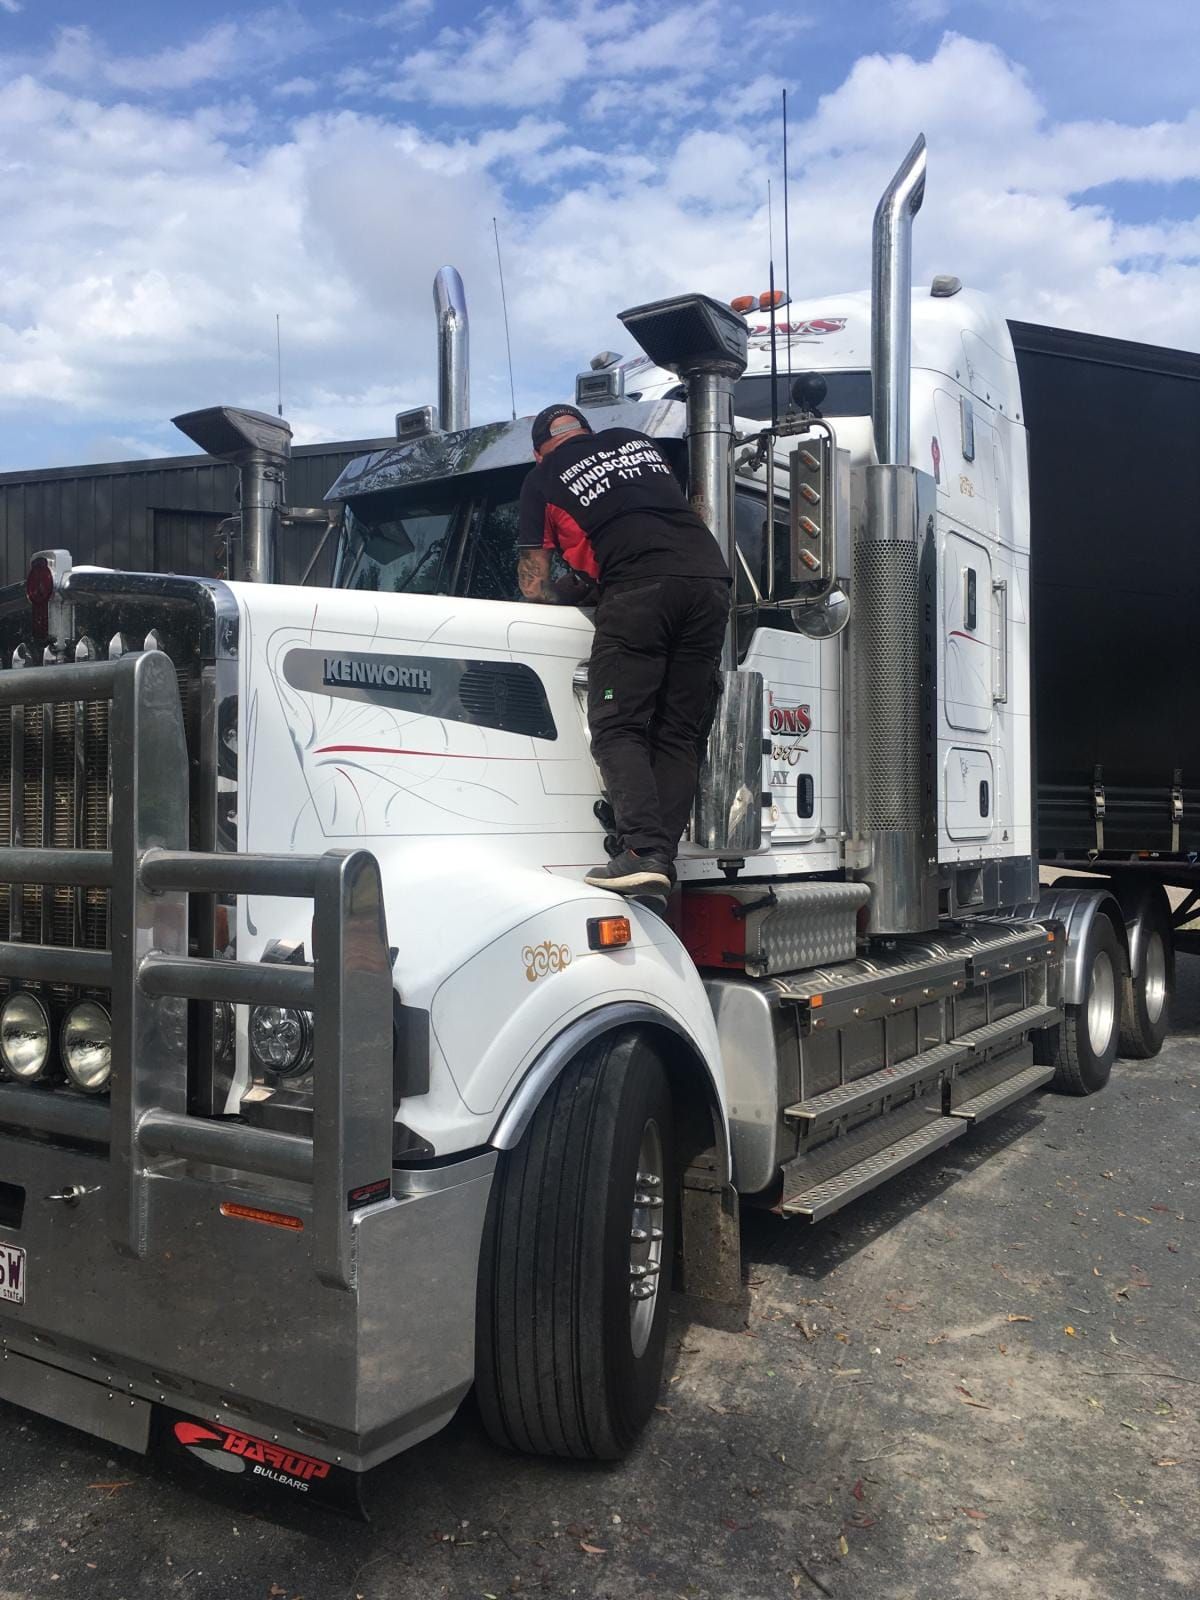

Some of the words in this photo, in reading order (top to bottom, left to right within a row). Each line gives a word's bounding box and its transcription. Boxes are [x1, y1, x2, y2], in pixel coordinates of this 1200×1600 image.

[559, 455, 598, 484] HERVEY
[568, 449, 663, 496] WINDSCREENS
[579, 477, 612, 507] 0447
[618, 467, 642, 480] 177
[324, 658, 431, 690] KENWORTH
[253, 1465, 310, 1493] BULLBARS
